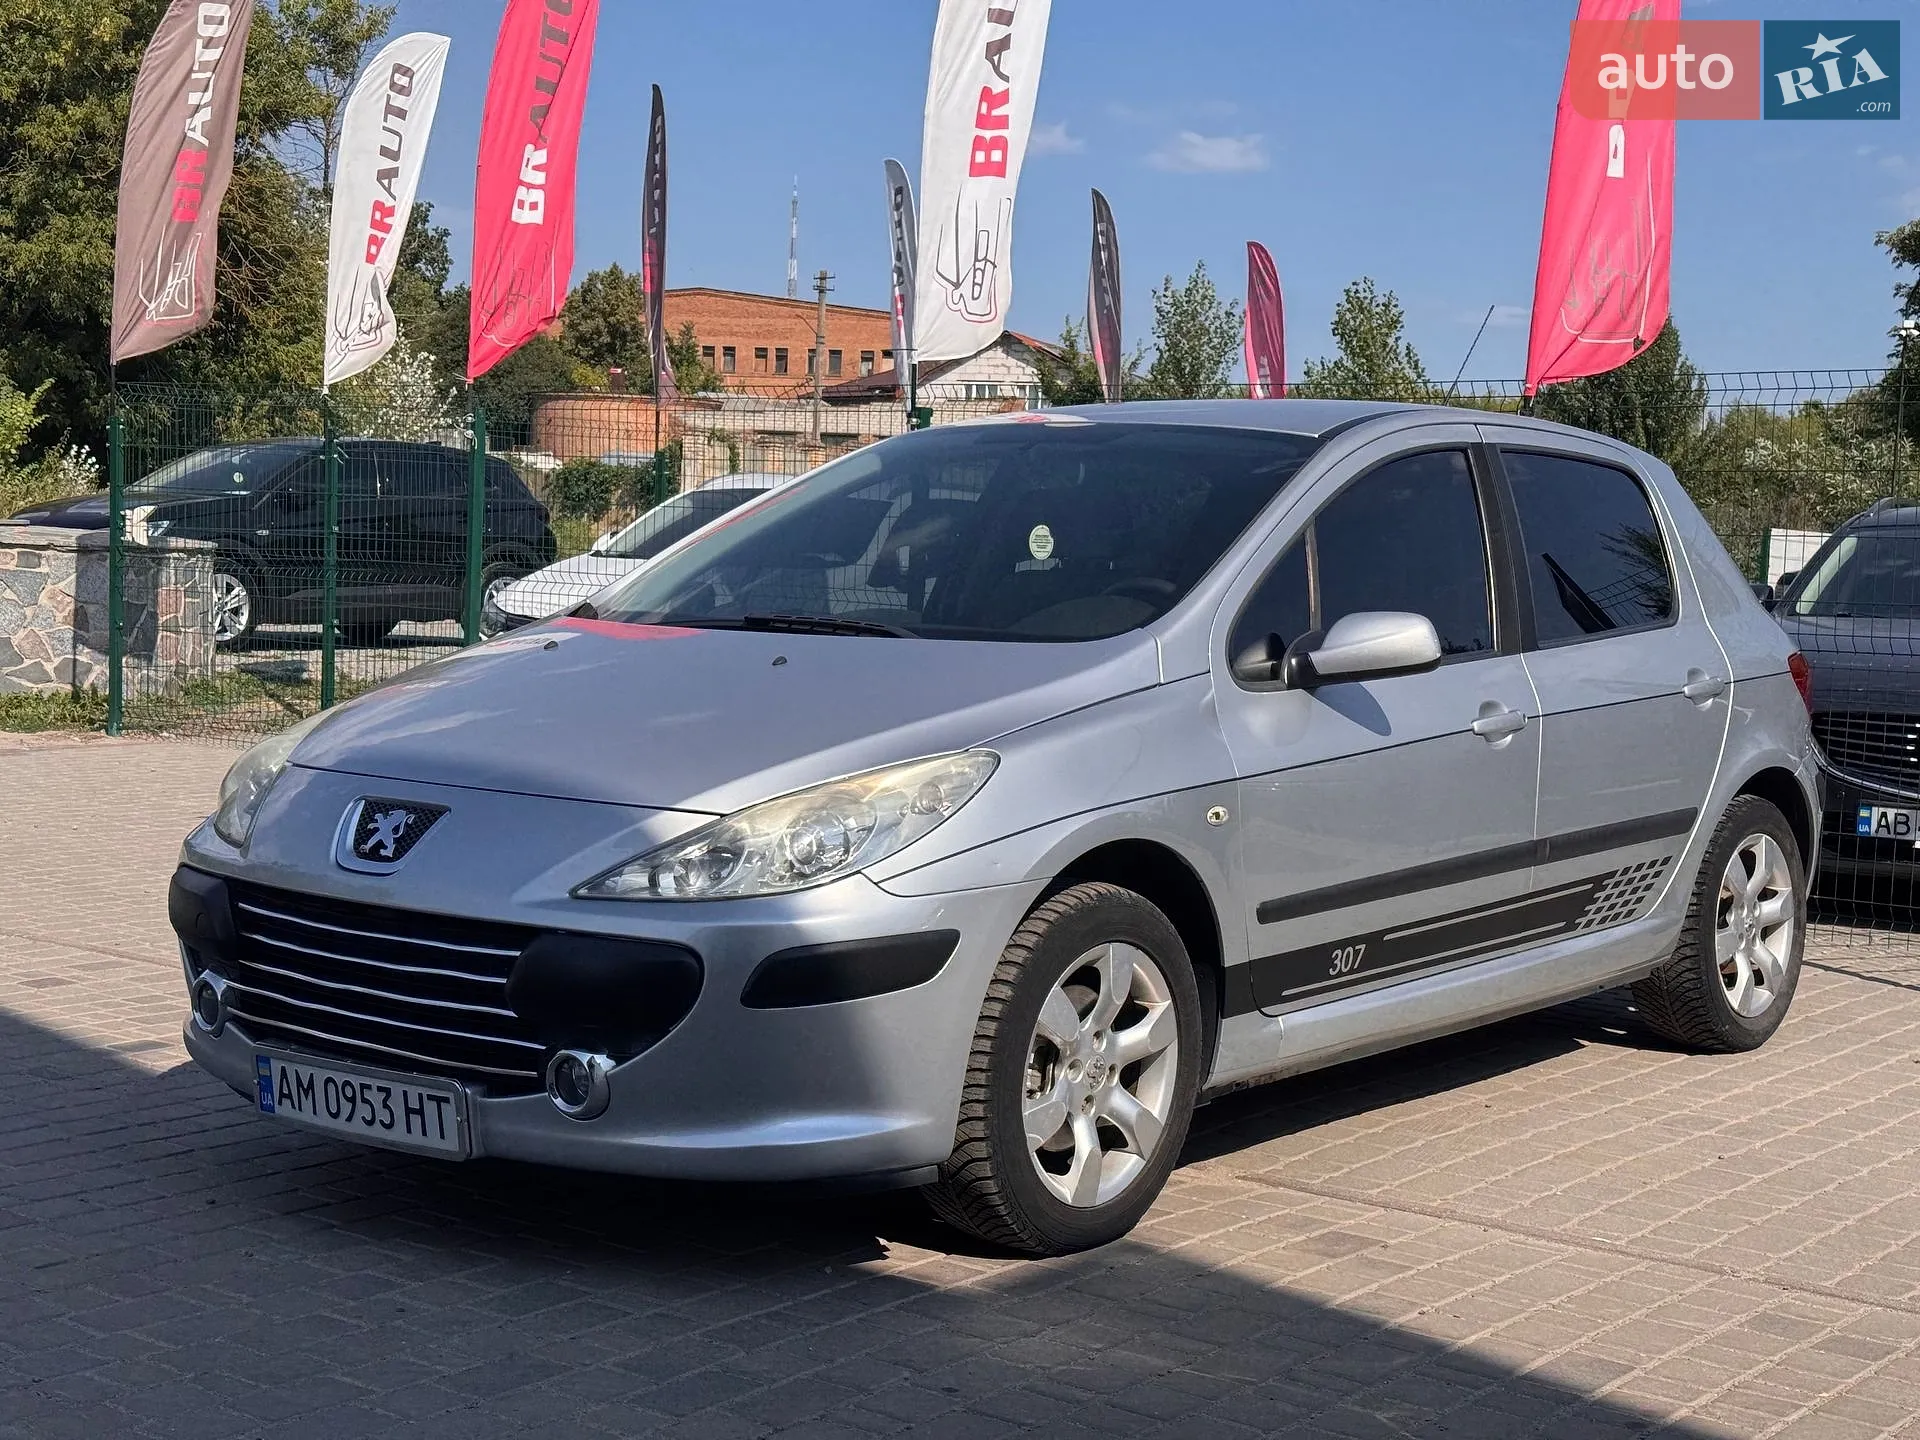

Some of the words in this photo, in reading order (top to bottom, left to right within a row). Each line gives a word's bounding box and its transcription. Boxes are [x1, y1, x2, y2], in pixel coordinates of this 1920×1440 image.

[1859, 824, 1870, 832] UA
[1875, 811, 1911, 835] AB
[1329, 944, 1366, 976] 307
[261, 1092, 274, 1106] UA
[277, 1065, 317, 1115] AM
[323, 1076, 395, 1130] 0953
[402, 1090, 451, 1140] HT
